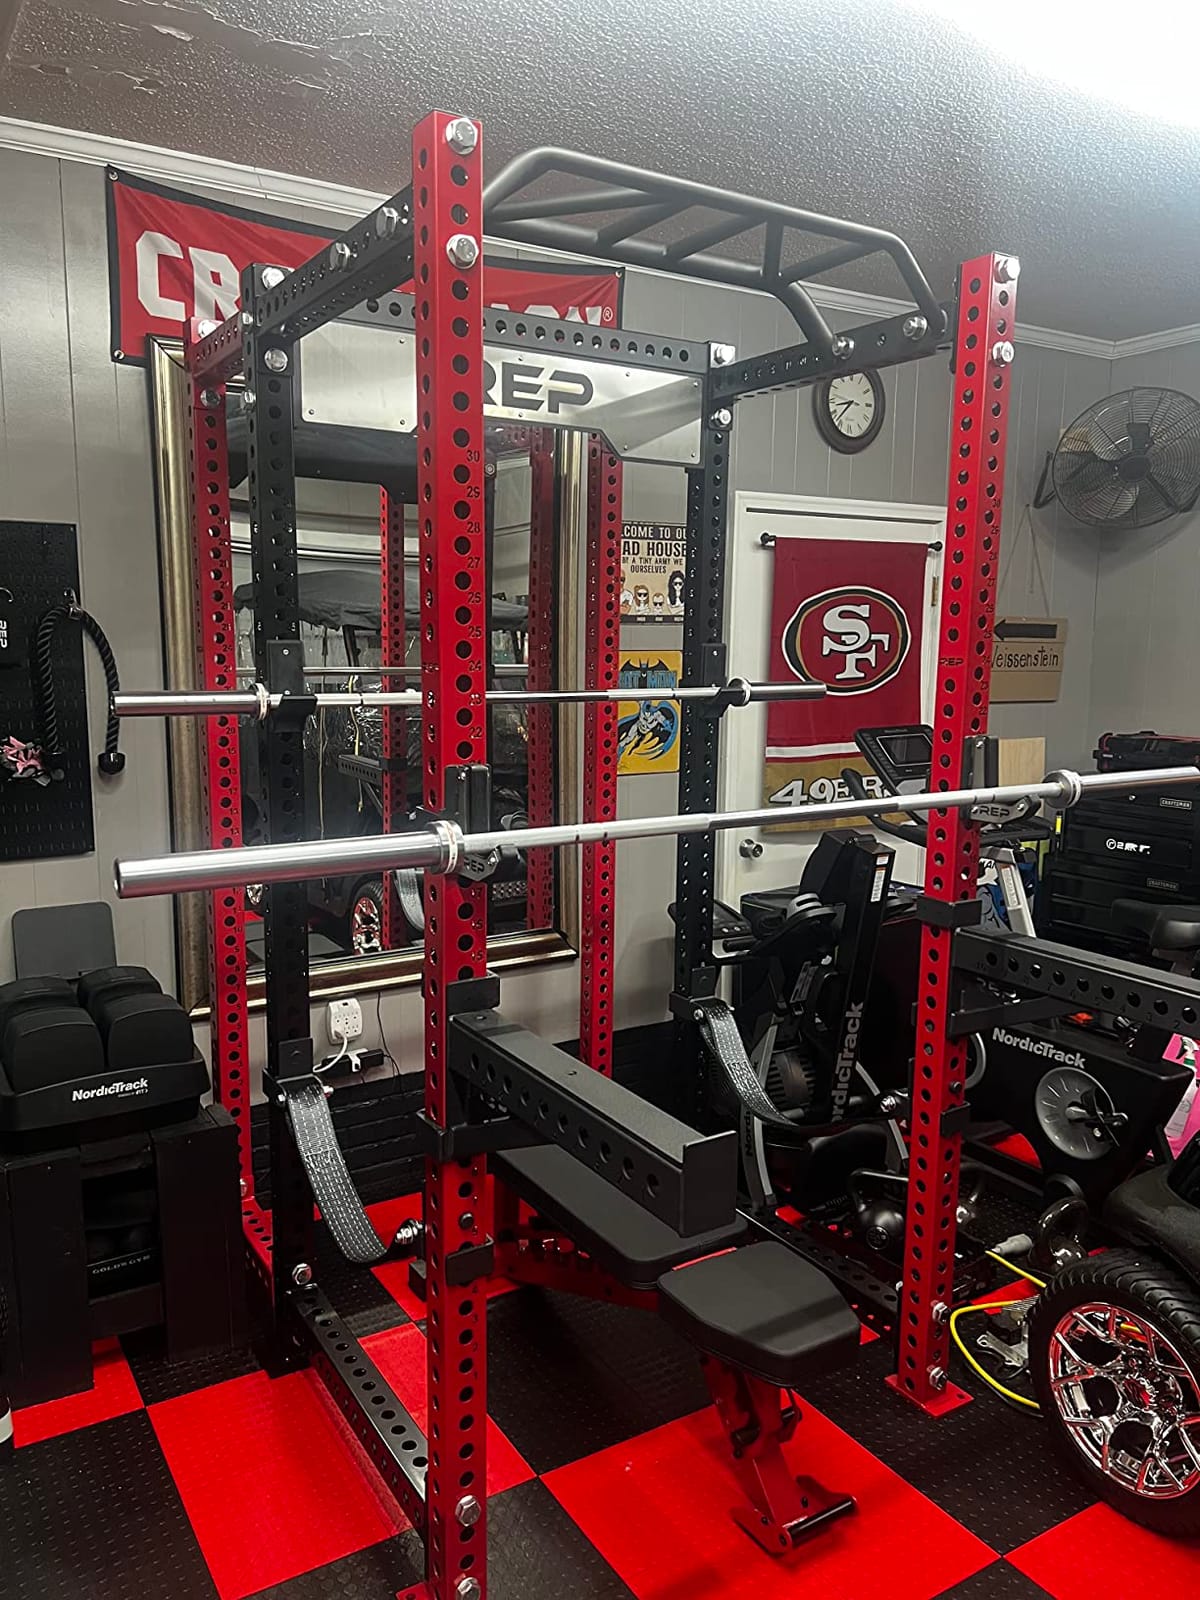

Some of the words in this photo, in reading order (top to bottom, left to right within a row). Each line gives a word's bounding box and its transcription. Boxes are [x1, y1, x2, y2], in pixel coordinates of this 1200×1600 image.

[466, 449, 480, 462] 30
[467, 521, 481, 534] 28
[621, 524, 653, 538] COME
[659, 527, 671, 539] TO
[676, 528, 687, 540] OU
[622, 541, 640, 556] AD
[647, 541, 687, 557] HOUSE
[467, 556, 481, 569] 27
[630, 564, 667, 574] OURSELVES
[468, 626, 482, 639] 25
[469, 727, 482, 739] 22
[769, 775, 891, 806] 49ER
[979, 805, 1010, 818] REP
[992, 1027, 1086, 1069] NordicTrack
[831, 1001, 864, 1123] ordicTrack
[72, 1077, 148, 1102] NordicTrack
